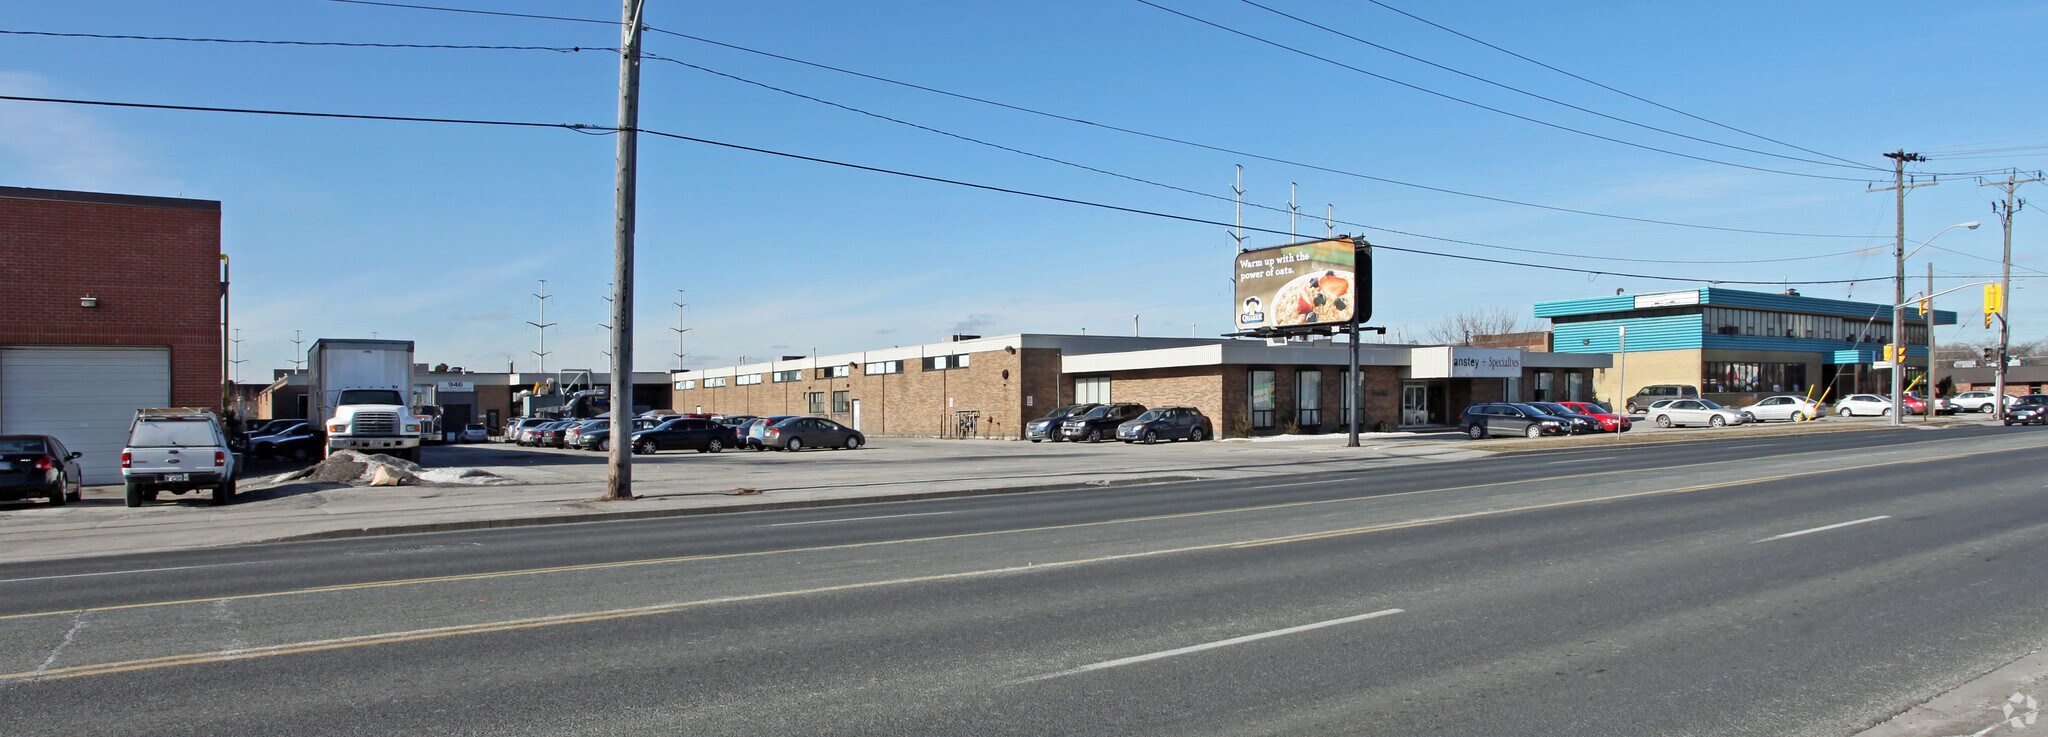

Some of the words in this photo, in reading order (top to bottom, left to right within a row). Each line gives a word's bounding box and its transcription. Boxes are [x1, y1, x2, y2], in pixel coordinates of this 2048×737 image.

[1240, 260, 1262, 269] Warm
[1276, 253, 1294, 264] with
[1296, 251, 1310, 261] the
[1240, 271, 1263, 282] power
[1265, 267, 1274, 277] of
[1275, 267, 1295, 275] oats.
[1453, 357, 1479, 369] anstey
